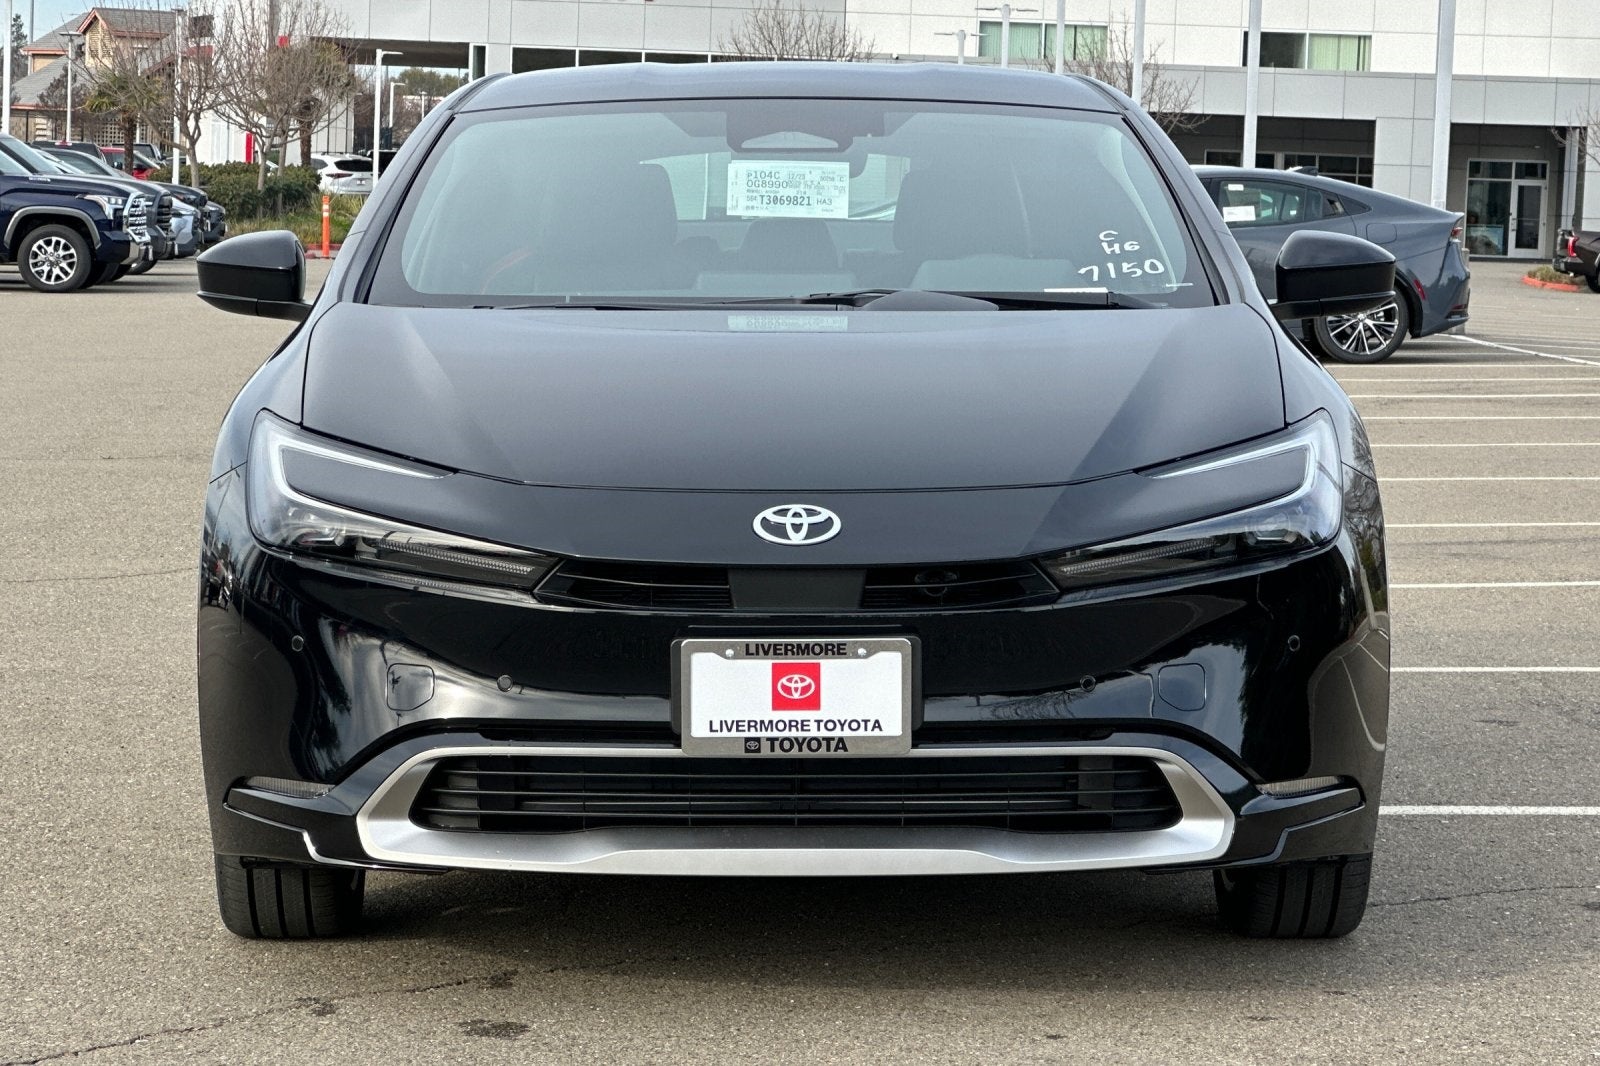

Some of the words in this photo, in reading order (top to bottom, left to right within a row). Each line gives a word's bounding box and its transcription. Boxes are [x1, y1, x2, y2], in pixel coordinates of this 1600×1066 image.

[759, 194, 812, 206] T3069821
[1077, 258, 1165, 282] 7150
[745, 643, 847, 656] LIVERMORE
[709, 719, 810, 733] LIVERMORE
[812, 719, 883, 732] TOYOTA
[767, 737, 848, 753] TOYOTA
